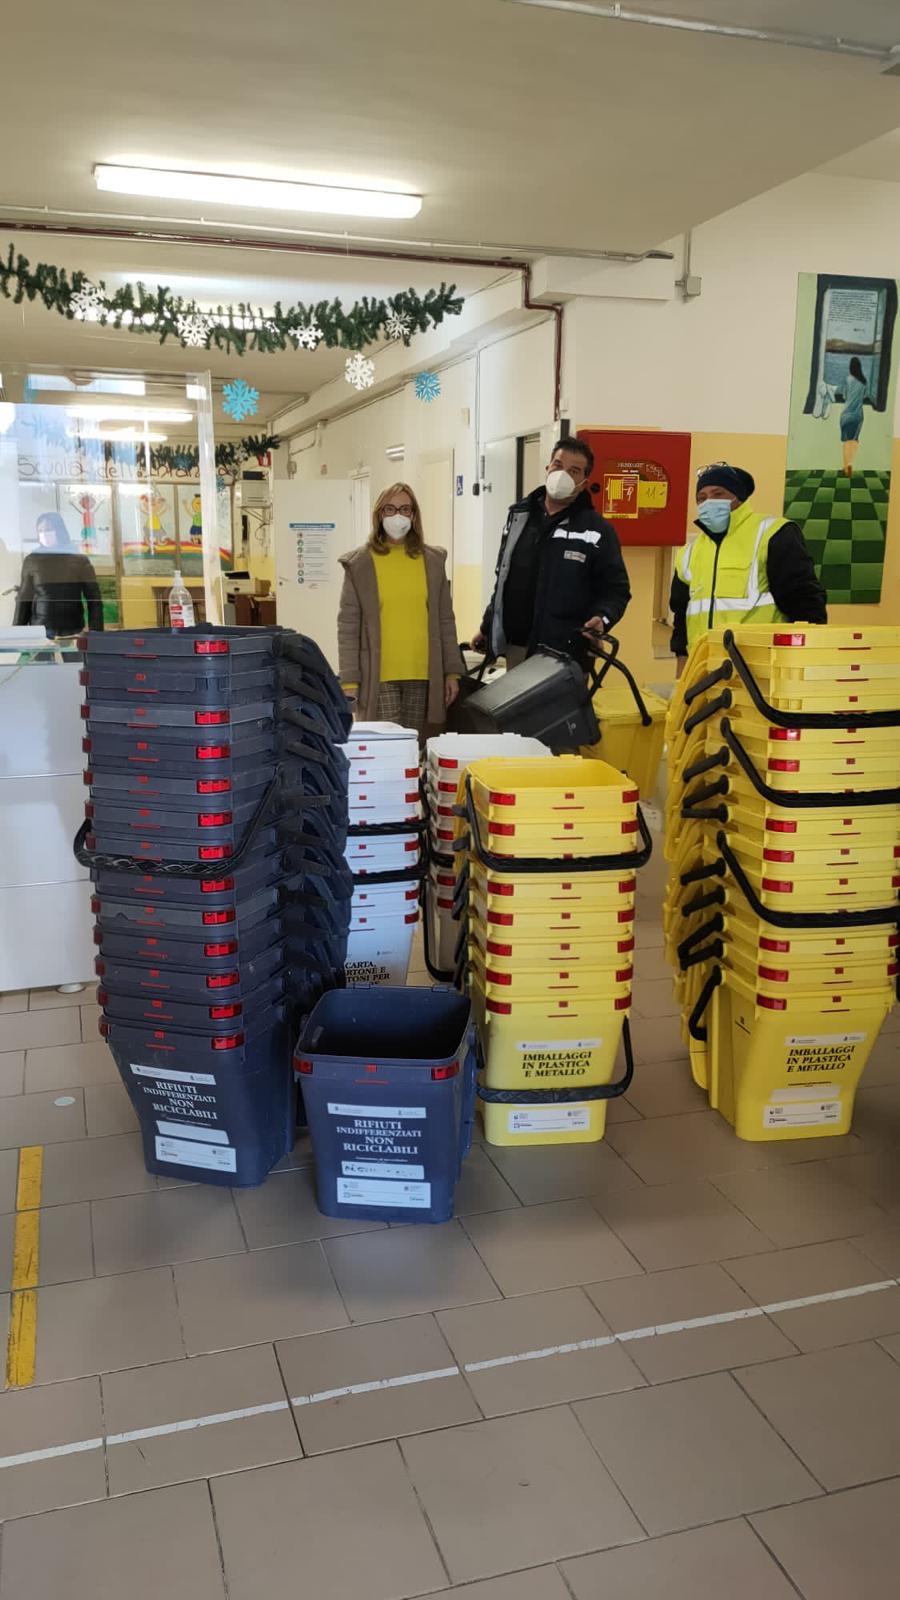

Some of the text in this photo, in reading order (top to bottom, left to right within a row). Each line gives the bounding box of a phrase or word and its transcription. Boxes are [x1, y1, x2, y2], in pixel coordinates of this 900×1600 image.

[346, 967, 378, 976] RTONE
[346, 975, 370, 983] TONI
[523, 1051, 592, 1061] IMBALLAGGI
[789, 1045, 856, 1057] IMBALLAGGI
[538, 1060, 590, 1070] PLASTICA
[786, 1054, 852, 1065] IN PLASTICA
[525, 1068, 586, 1078] E METALLO
[787, 1062, 846, 1073] E METALLO
[155, 1081, 197, 1094] RIFIUTI
[142, 1087, 216, 1103] INDIFFERENZIATI
[169, 1098, 194, 1109] NON
[152, 1103, 218, 1120] RICICLABILI
[354, 1119, 402, 1130] RIFIUTI
[336, 1126, 422, 1137] INDIFFERENZIATI
[365, 1136, 394, 1145] NON
[343, 1142, 418, 1154] RICICLABILI
